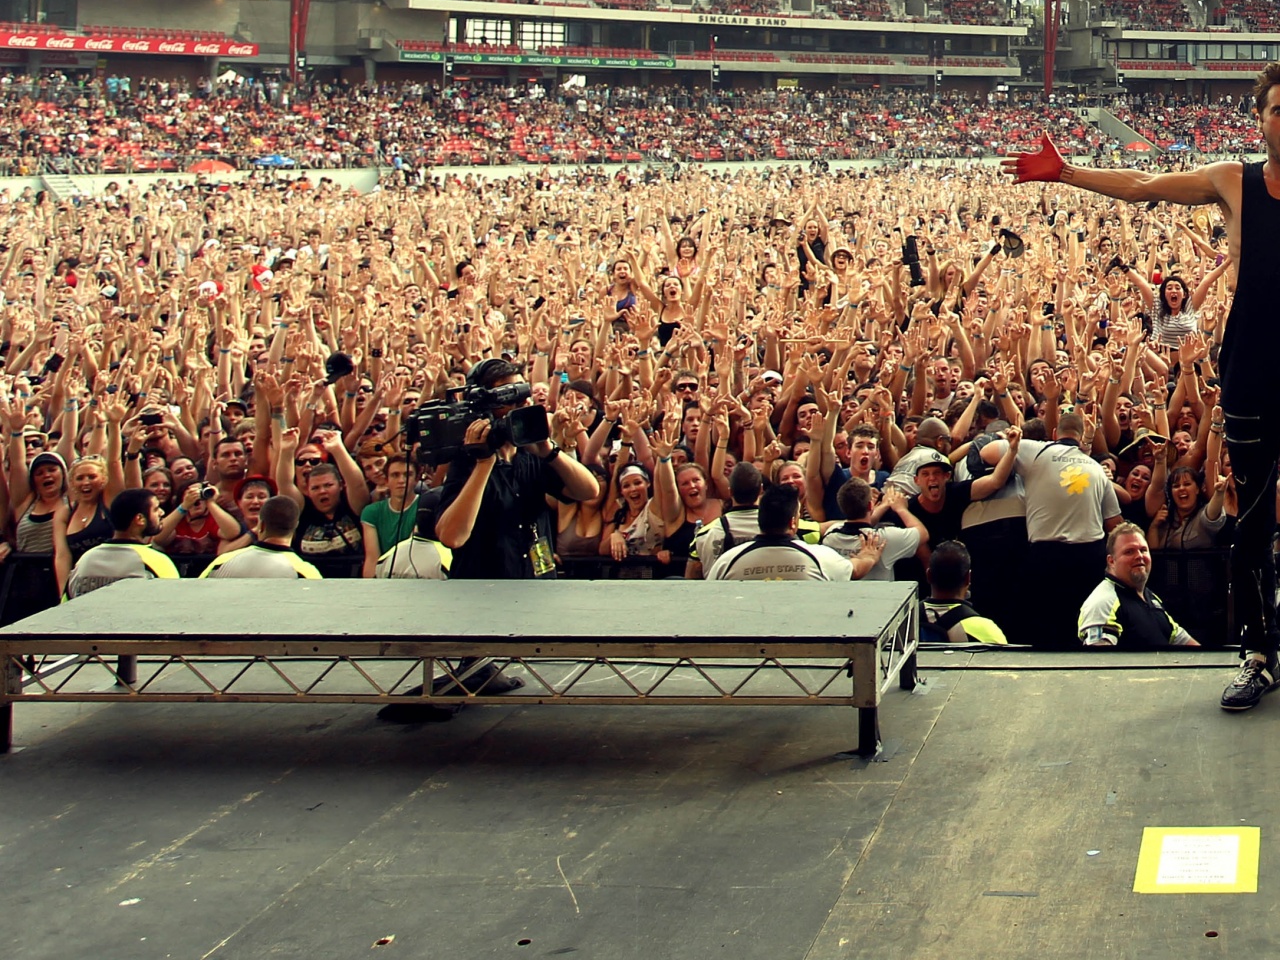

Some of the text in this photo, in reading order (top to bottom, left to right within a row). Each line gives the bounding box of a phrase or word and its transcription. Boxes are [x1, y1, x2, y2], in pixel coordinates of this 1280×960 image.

[698, 15, 787, 26] SINCLAIR STAND
[743, 564, 806, 576] EVENT STAFF
